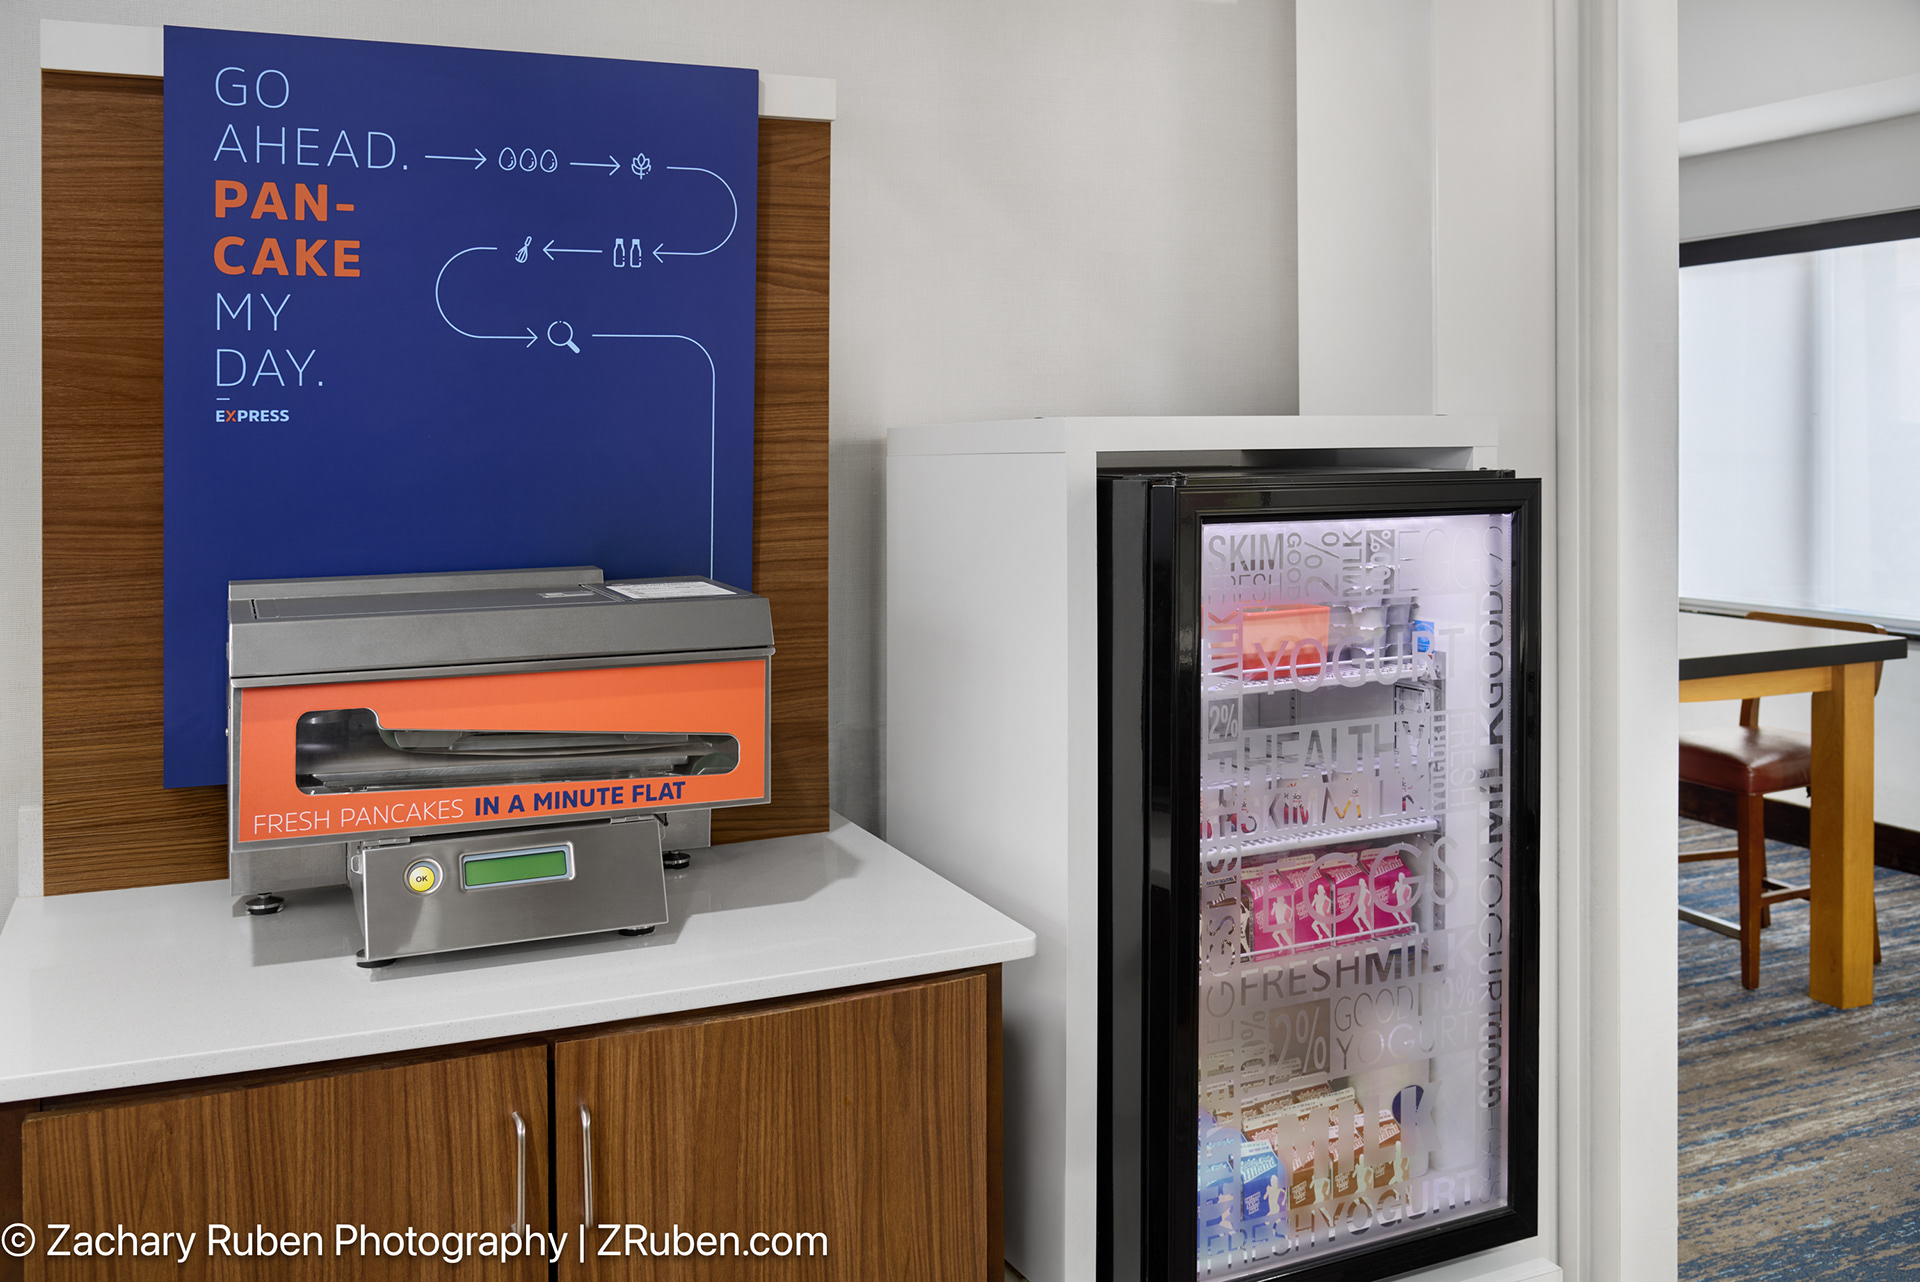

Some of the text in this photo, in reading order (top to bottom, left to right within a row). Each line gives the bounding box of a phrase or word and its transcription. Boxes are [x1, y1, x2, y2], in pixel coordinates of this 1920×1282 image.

[214, 66, 291, 109] GO
[213, 123, 409, 171] AHEAD.
[214, 179, 355, 222] PAN-
[213, 236, 361, 278] CAKE
[215, 293, 291, 332] MY
[215, 348, 324, 388] DAY.
[215, 409, 290, 423] EXPRESS
[1208, 532, 1284, 574] SKIM
[1342, 529, 1363, 597] MILK
[1252, 628, 1466, 696] YOGURT
[1209, 704, 1238, 740] 2%
[1244, 719, 1427, 790] HEALTHY
[253, 781, 687, 835] FRESH PANCAKES IN A MINUTE FLAT
[415, 875, 428, 883] OK
[1262, 836, 1460, 934] EGGS
[1334, 985, 1414, 1031] GOOD
[1275, 1007, 1327, 1077] 2%
[1336, 1012, 1473, 1070] YOGURT
[1277, 1082, 1443, 1188] MILK
